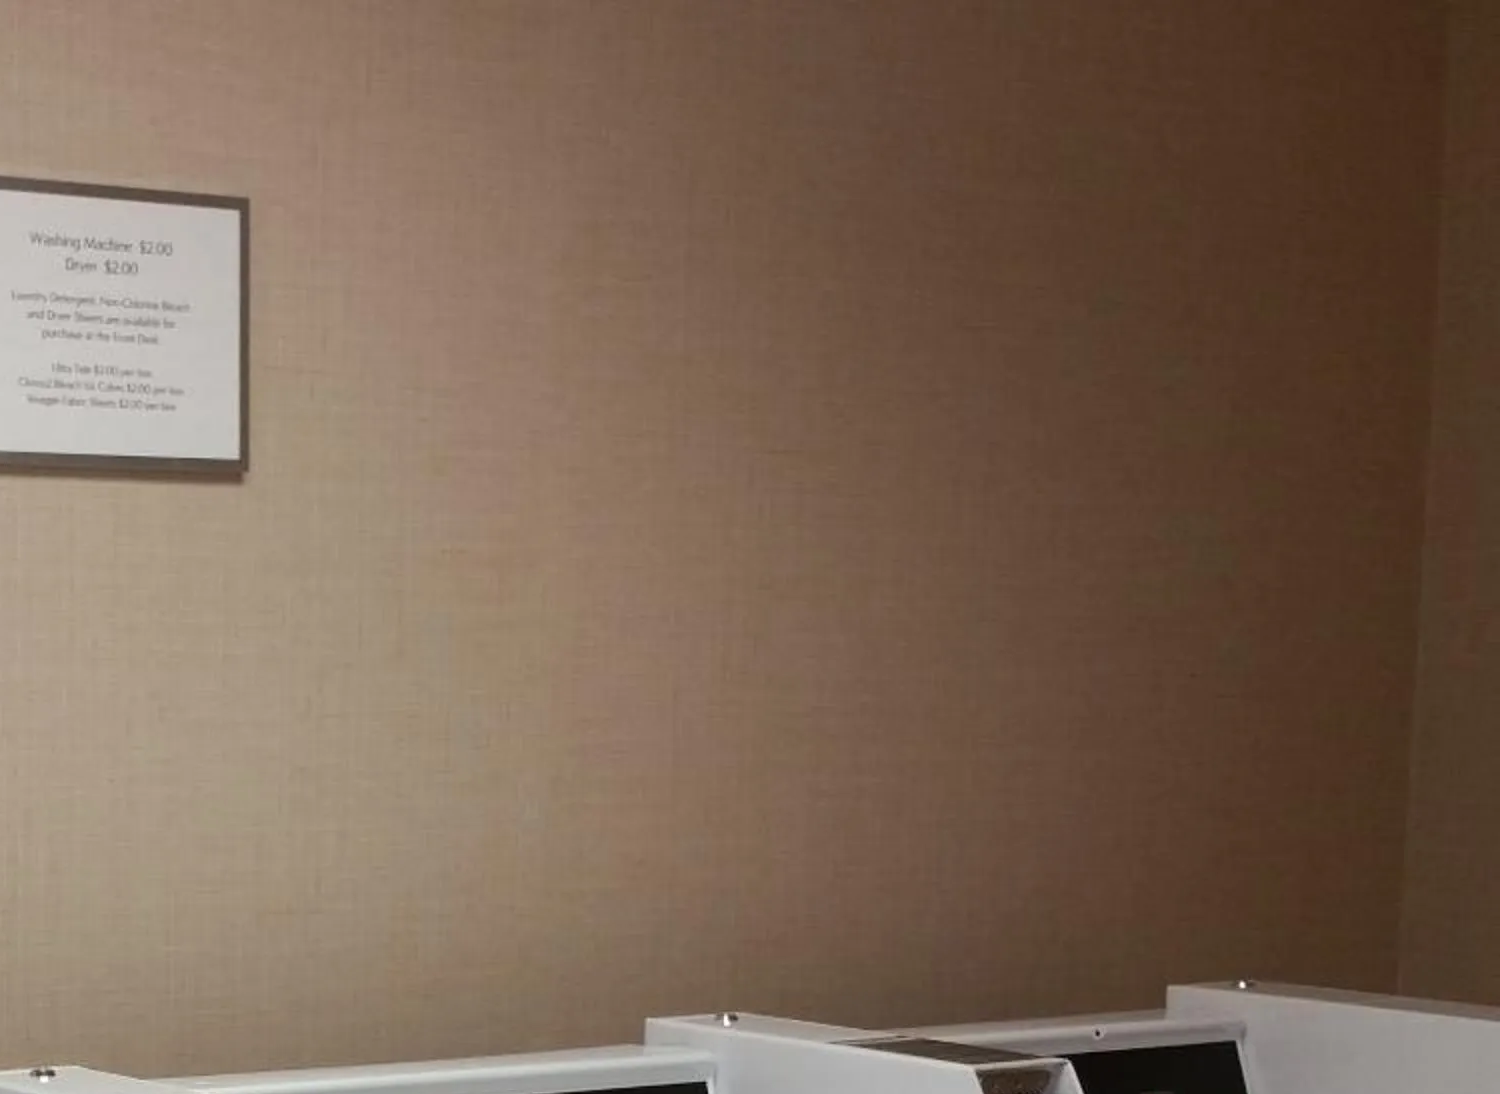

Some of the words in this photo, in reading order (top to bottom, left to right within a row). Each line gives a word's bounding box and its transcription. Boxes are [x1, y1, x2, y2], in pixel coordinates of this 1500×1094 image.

[28, 231, 81, 252] Washing
[83, 236, 133, 252] Machine
[139, 239, 173, 256] $2.00
[104, 259, 139, 275] $2.00
